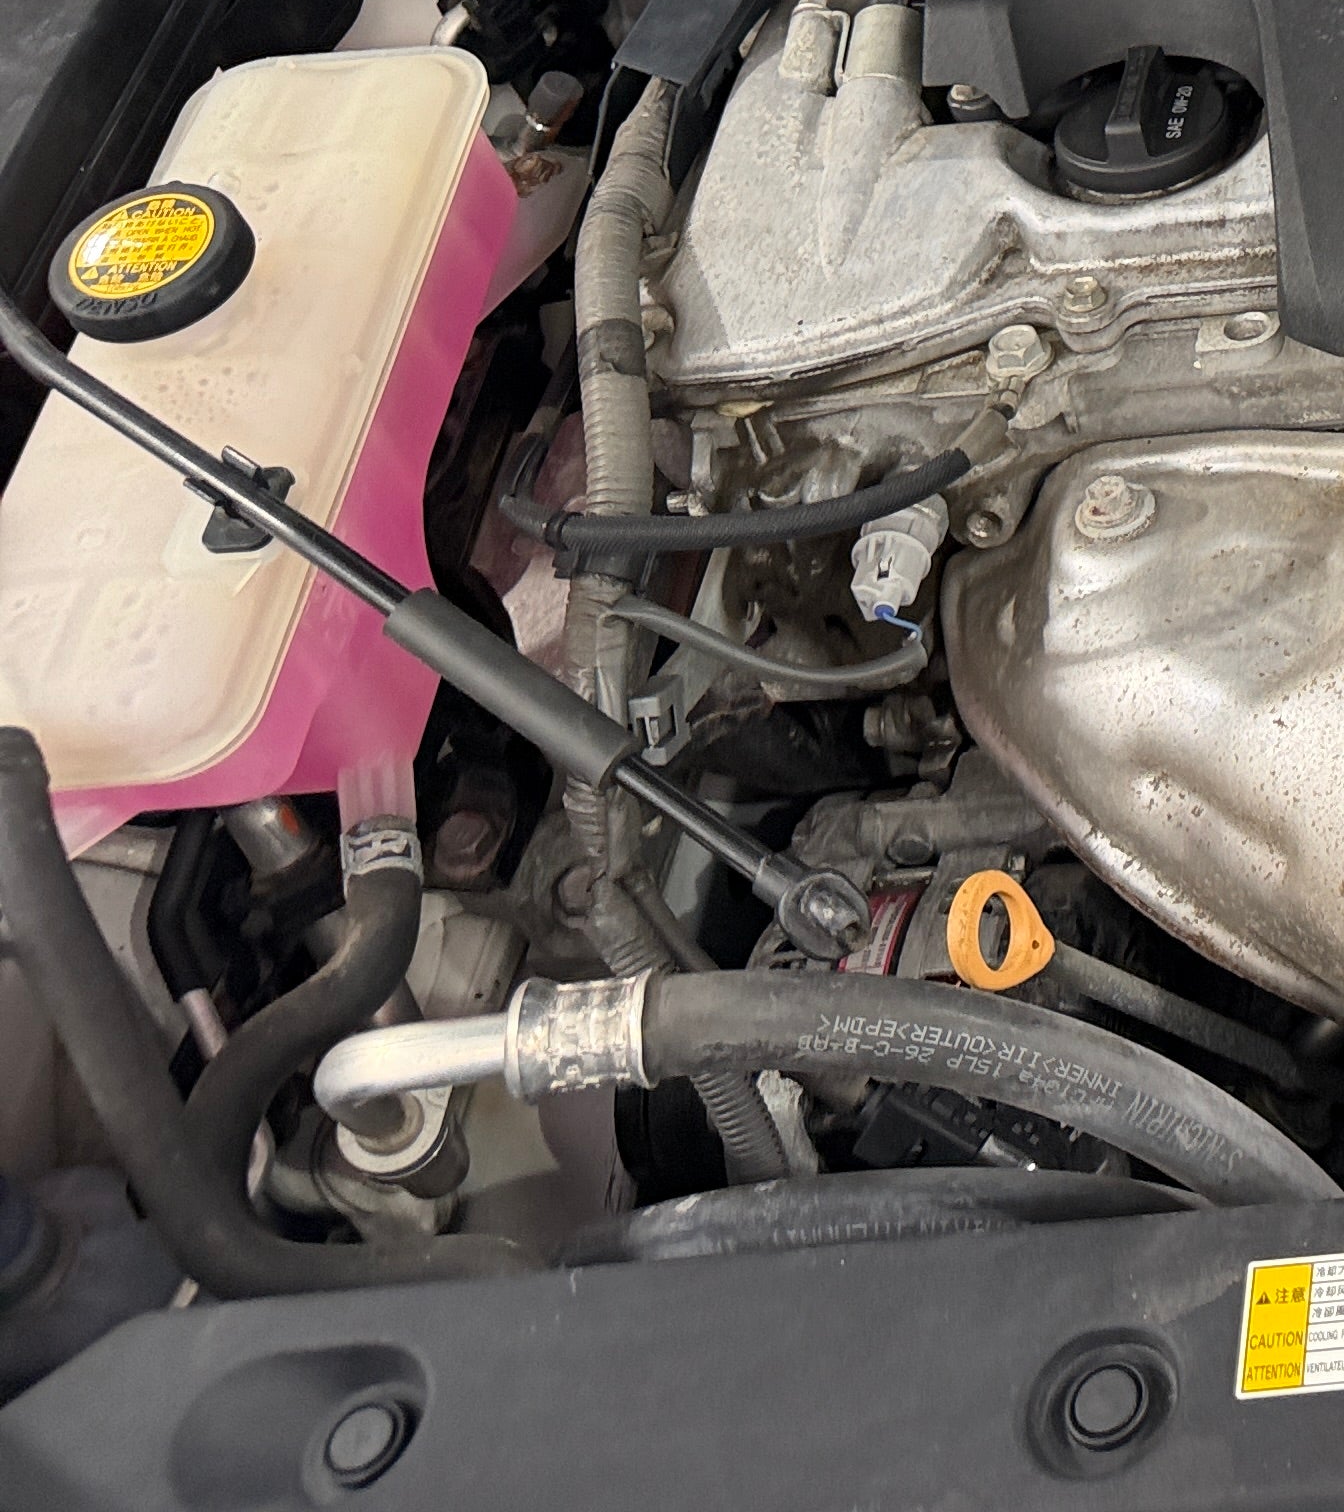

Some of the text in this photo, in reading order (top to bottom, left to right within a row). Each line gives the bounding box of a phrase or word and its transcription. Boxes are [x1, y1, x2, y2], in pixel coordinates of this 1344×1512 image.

[1165, 118, 1184, 139] SAE
[131, 206, 196, 220] CAUTION
[107, 260, 178, 275] ATTENTION
[75, 292, 159, 316] DENSO
[1275, 1287, 1306, 1304] 注意
[1249, 1331, 1303, 1350] CAUTION
[1308, 1329, 1338, 1343] COOLING
[1246, 1362, 1302, 1382] ATTENTION
